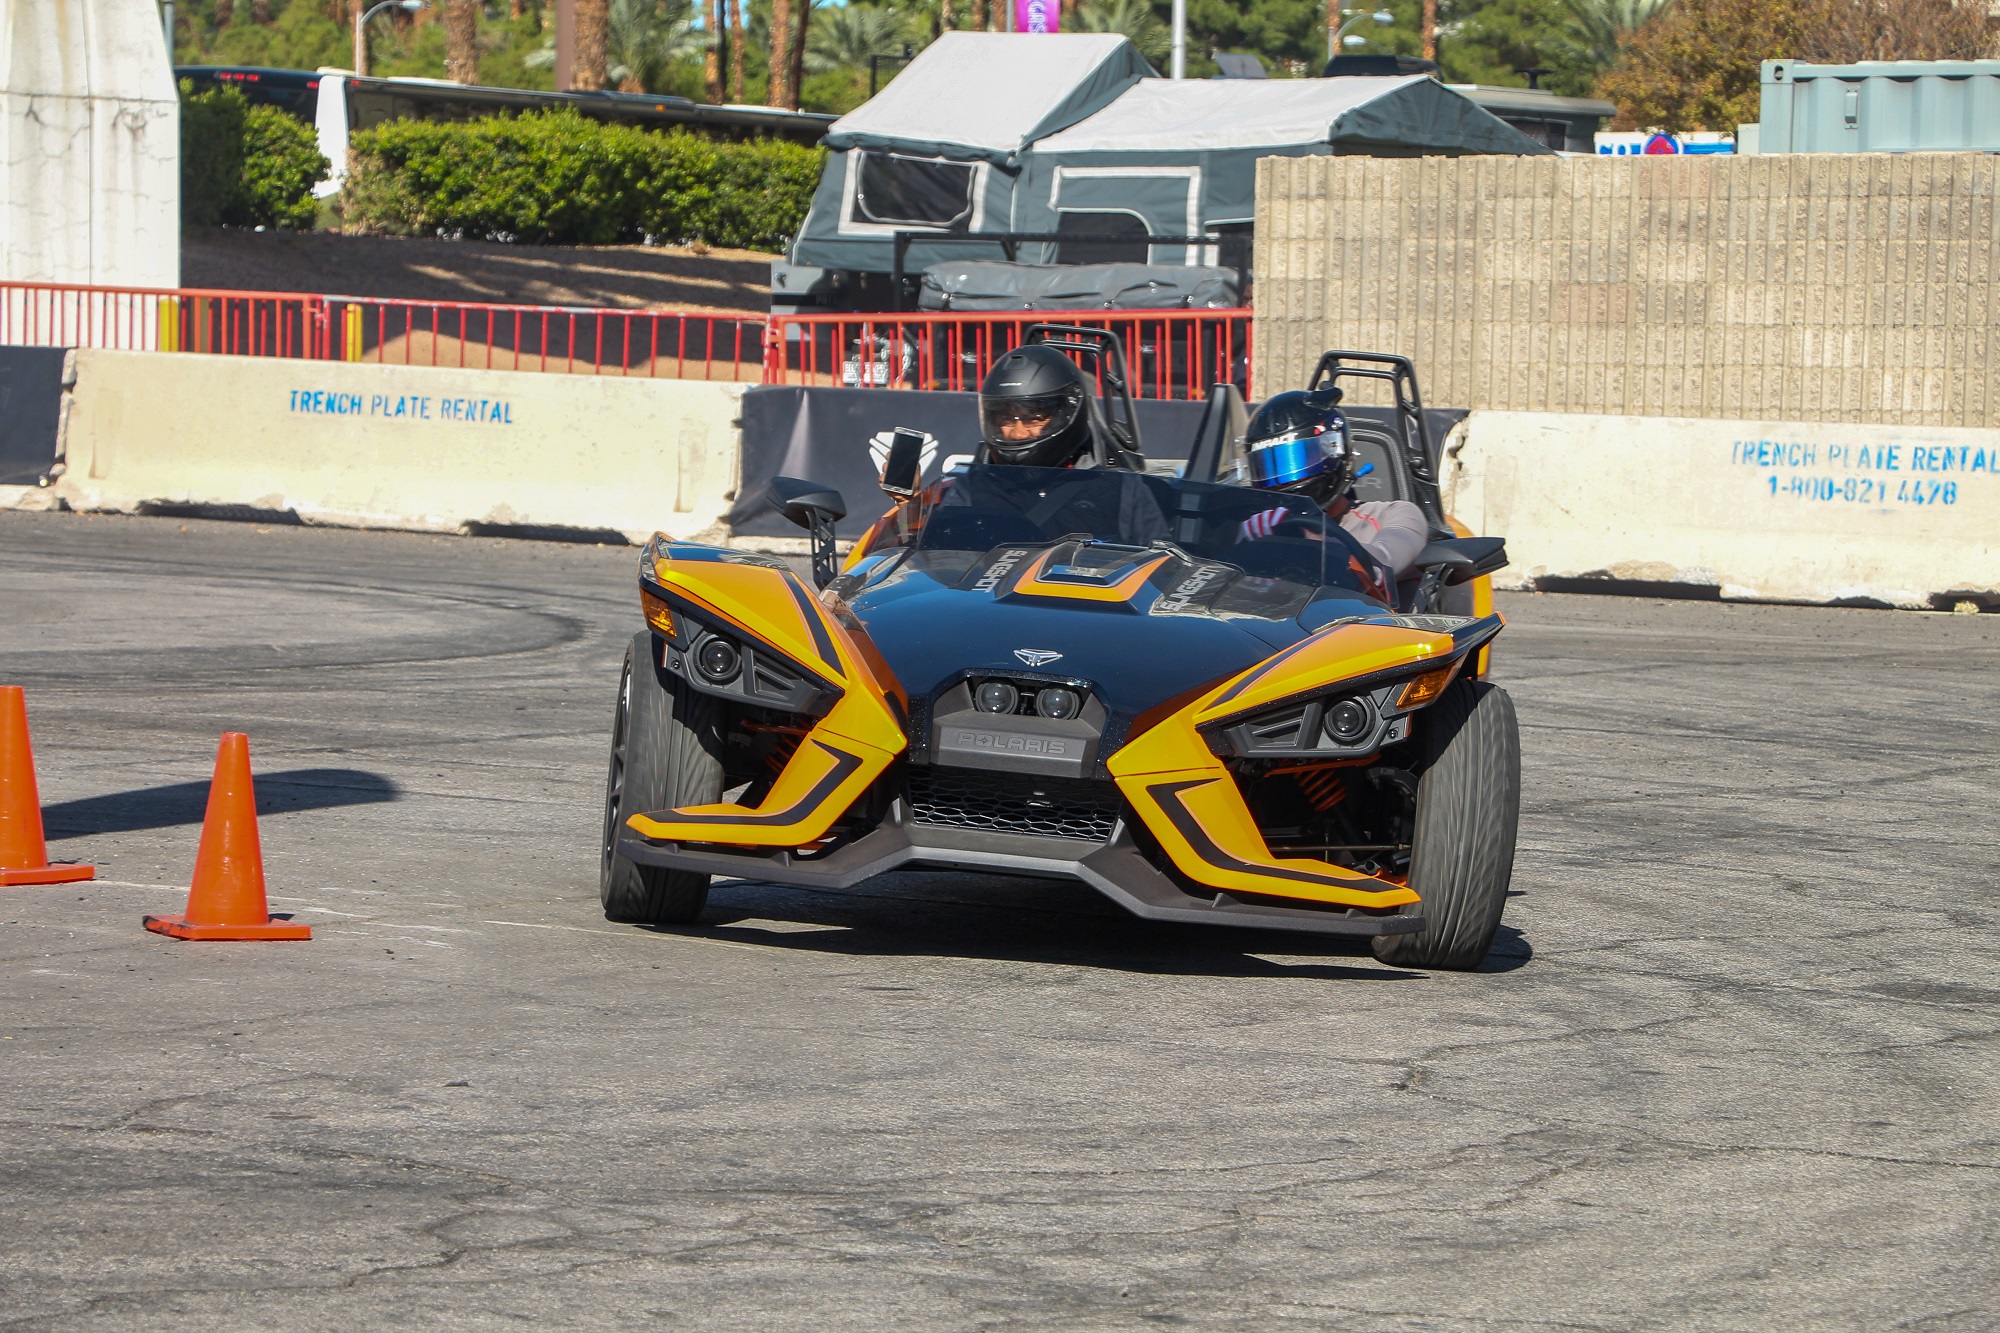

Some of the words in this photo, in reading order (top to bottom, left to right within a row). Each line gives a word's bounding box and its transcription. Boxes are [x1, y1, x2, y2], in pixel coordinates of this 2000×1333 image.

[290, 390, 363, 415] TRENCH
[370, 394, 432, 420] PLATE
[441, 398, 514, 424] RENTAL
[1731, 440, 1817, 468] TRENCH
[1828, 444, 1903, 471] PLATE
[1911, 445, 2000, 475] RENTAL
[958, 732, 1065, 754] POLARIS
